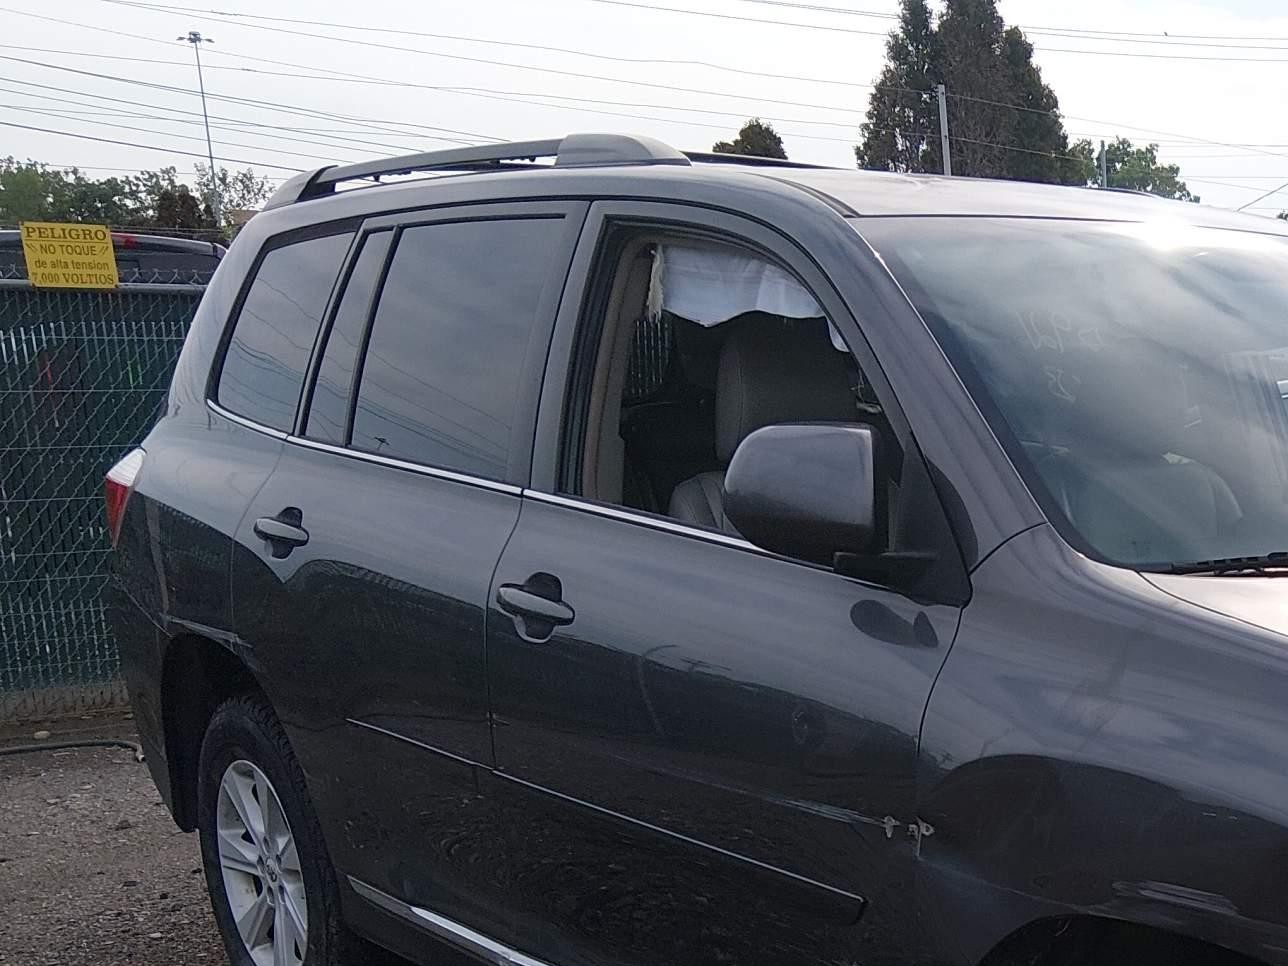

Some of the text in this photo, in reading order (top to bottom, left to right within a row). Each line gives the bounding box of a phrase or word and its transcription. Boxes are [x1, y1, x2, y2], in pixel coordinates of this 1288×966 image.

[24, 226, 107, 241] PELIGRO
[40, 243, 97, 256] NO TOQUE
[34, 258, 47, 269] de
[51, 258, 69, 270] alta
[62, 272, 115, 286] VOLTIOS
